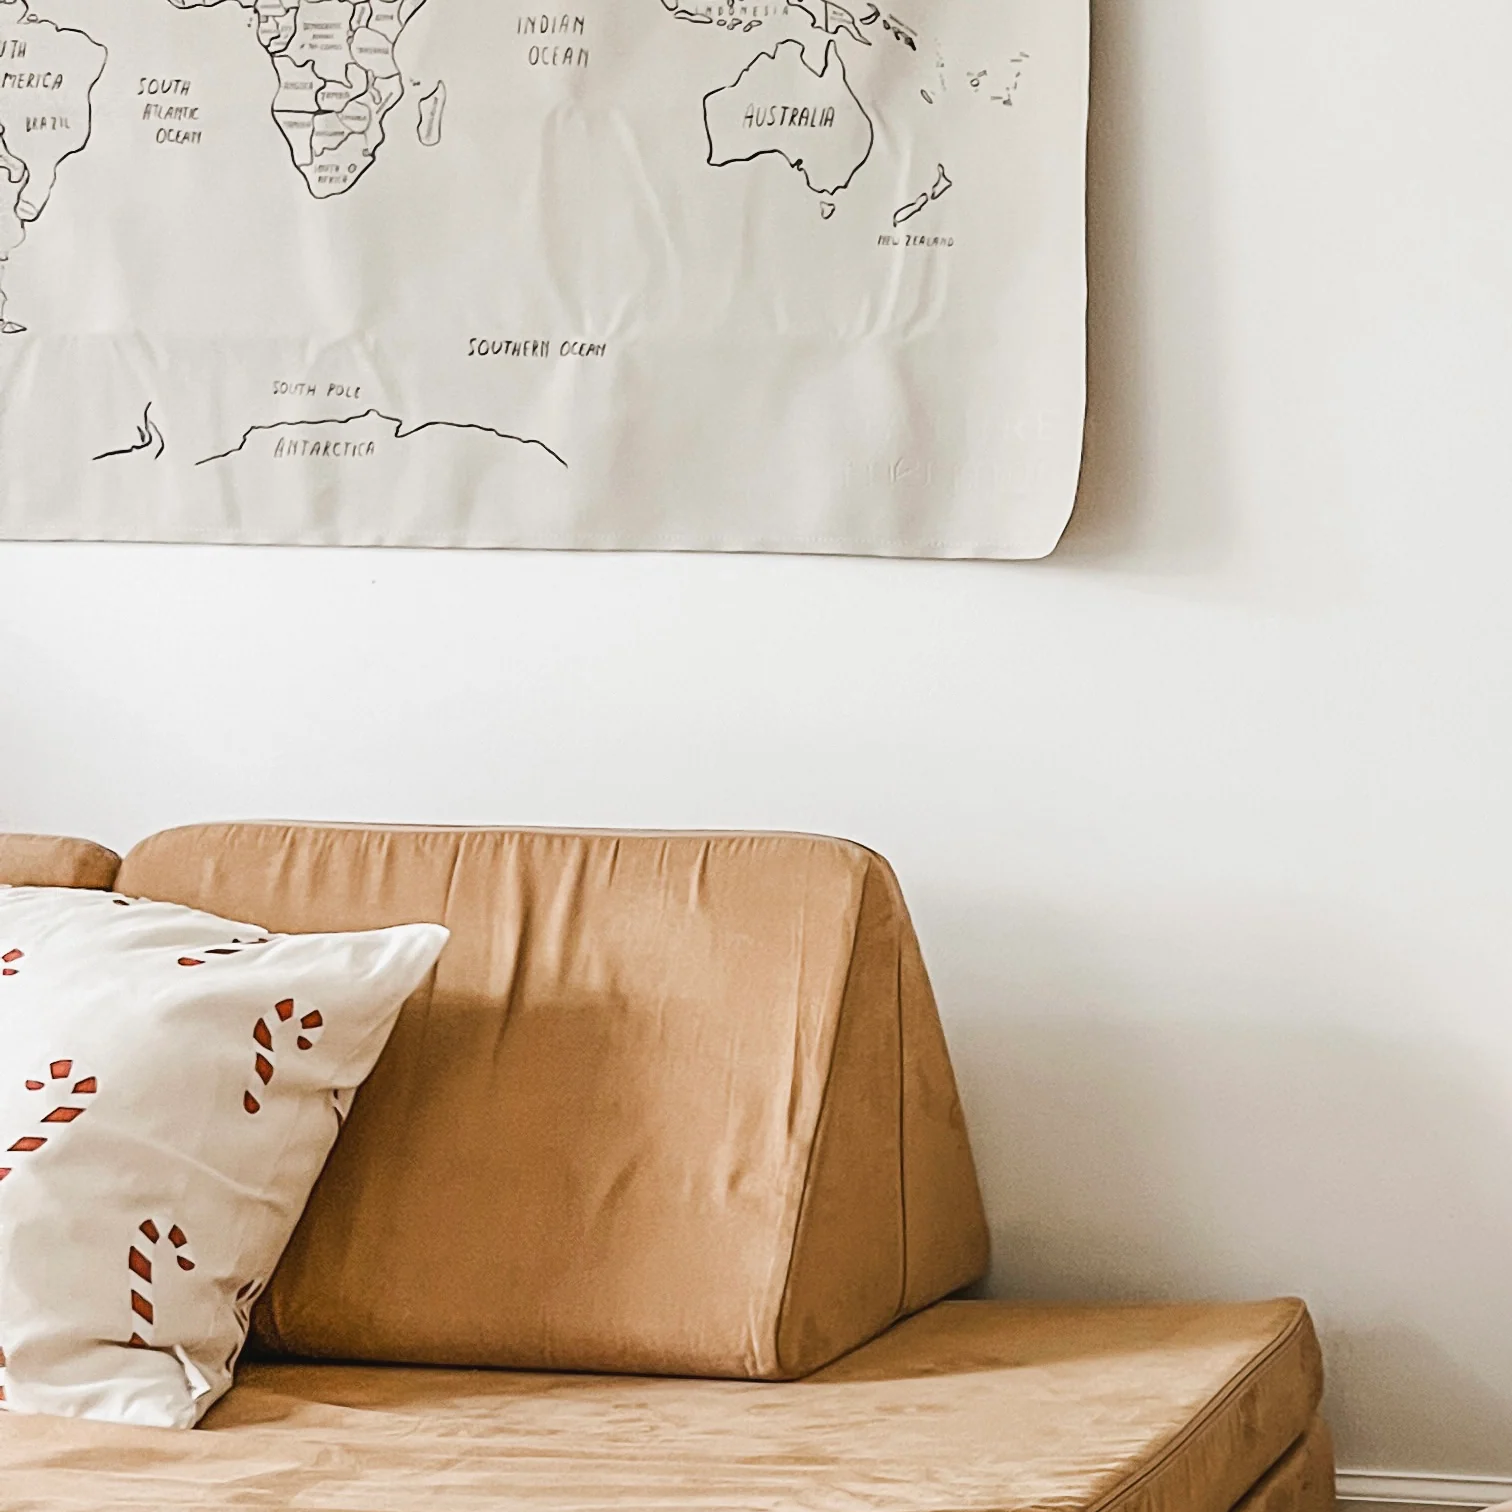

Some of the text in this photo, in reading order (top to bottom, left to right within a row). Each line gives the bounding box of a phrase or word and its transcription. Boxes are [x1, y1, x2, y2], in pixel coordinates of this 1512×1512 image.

[517, 14, 585, 35] INDIAN
[528, 45, 590, 68] OCEAN
[137, 77, 191, 95] SOUTH
[142, 103, 199, 120] ATLANTIC
[742, 103, 835, 128] AUSTRALIA
[26, 116, 71, 132] BRAZIL
[156, 128, 202, 144] OCEAN
[878, 234, 954, 247] NEW ZEALAND
[468, 337, 606, 358] SOUTHERN OCEAN
[273, 381, 361, 399] SOUTH POLE
[273, 437, 375, 458] ANTARCTICA
